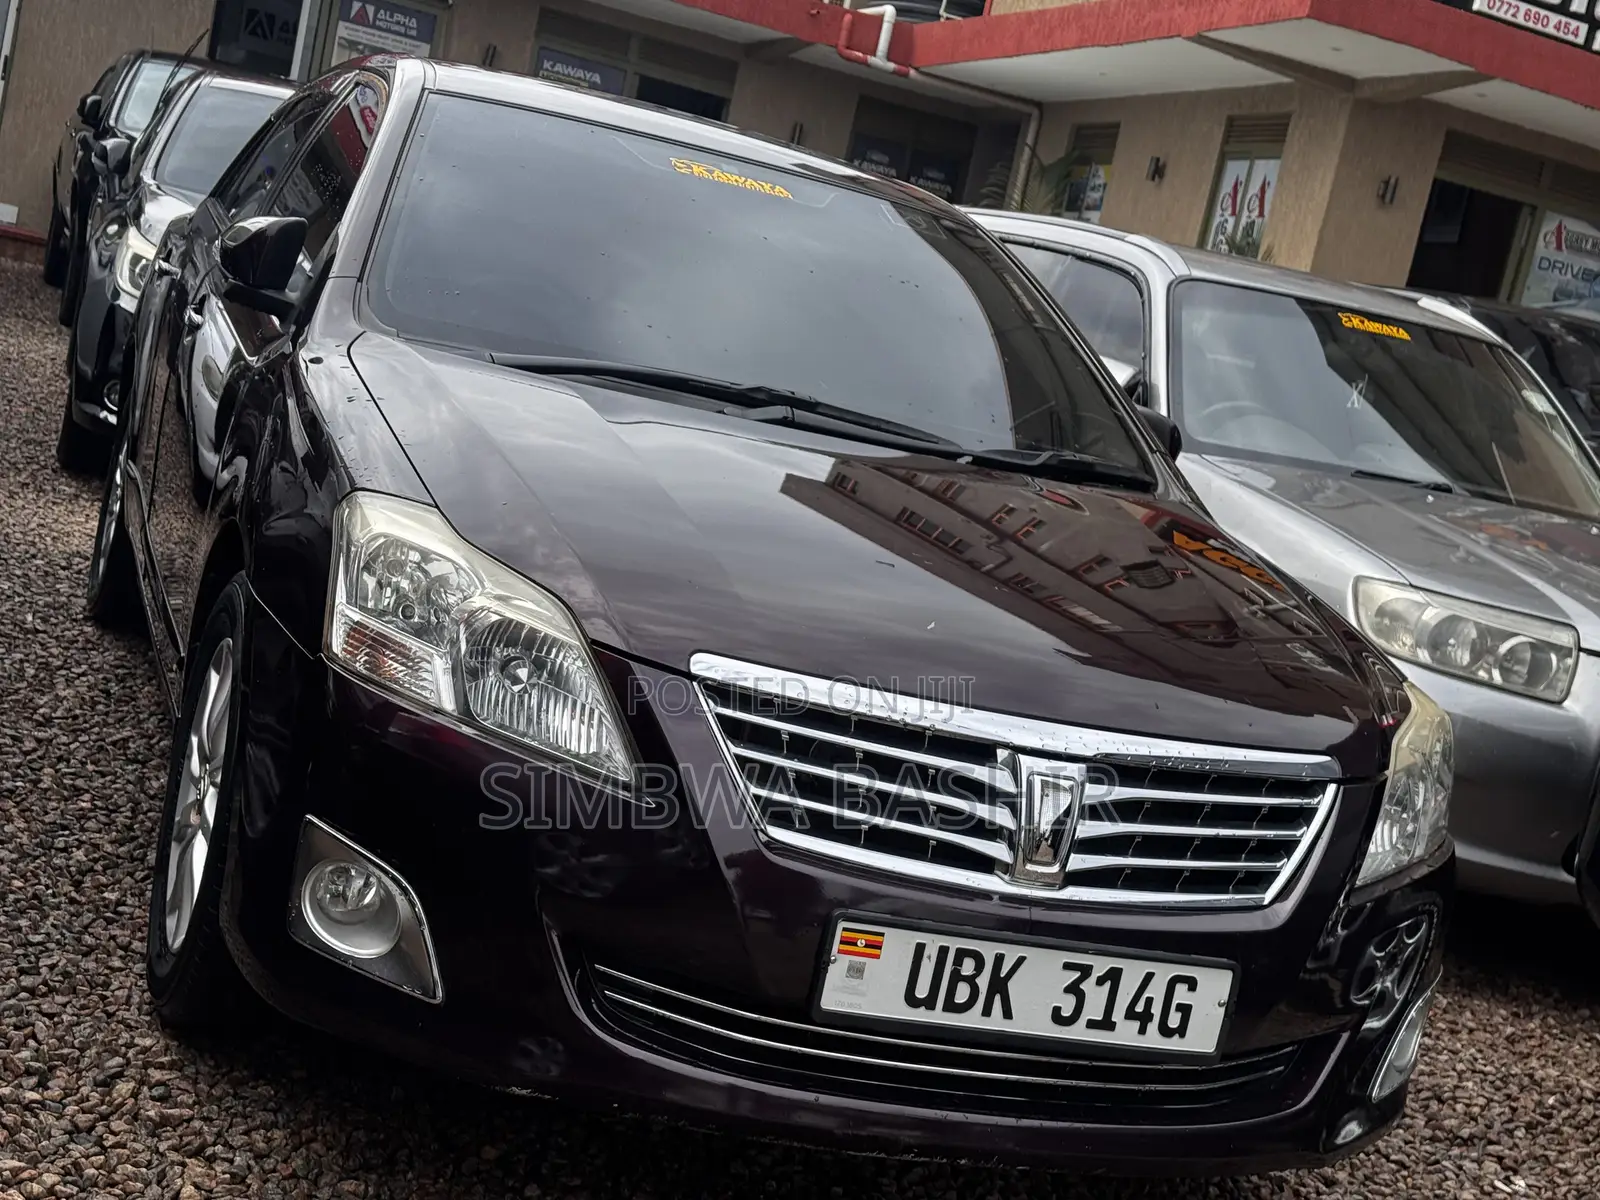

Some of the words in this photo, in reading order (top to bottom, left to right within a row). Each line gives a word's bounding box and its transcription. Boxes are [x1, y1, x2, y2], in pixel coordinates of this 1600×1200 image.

[376, 9, 417, 29] ALPHA
[1486, 0, 1520, 19] 0772
[1523, 7, 1550, 29] 690
[1553, 19, 1580, 39] 454
[542, 59, 602, 85] KAWAYA
[691, 163, 794, 200] KAWAYA
[904, 941, 1027, 1020] UBK
[1051, 961, 1198, 1038] 314G
